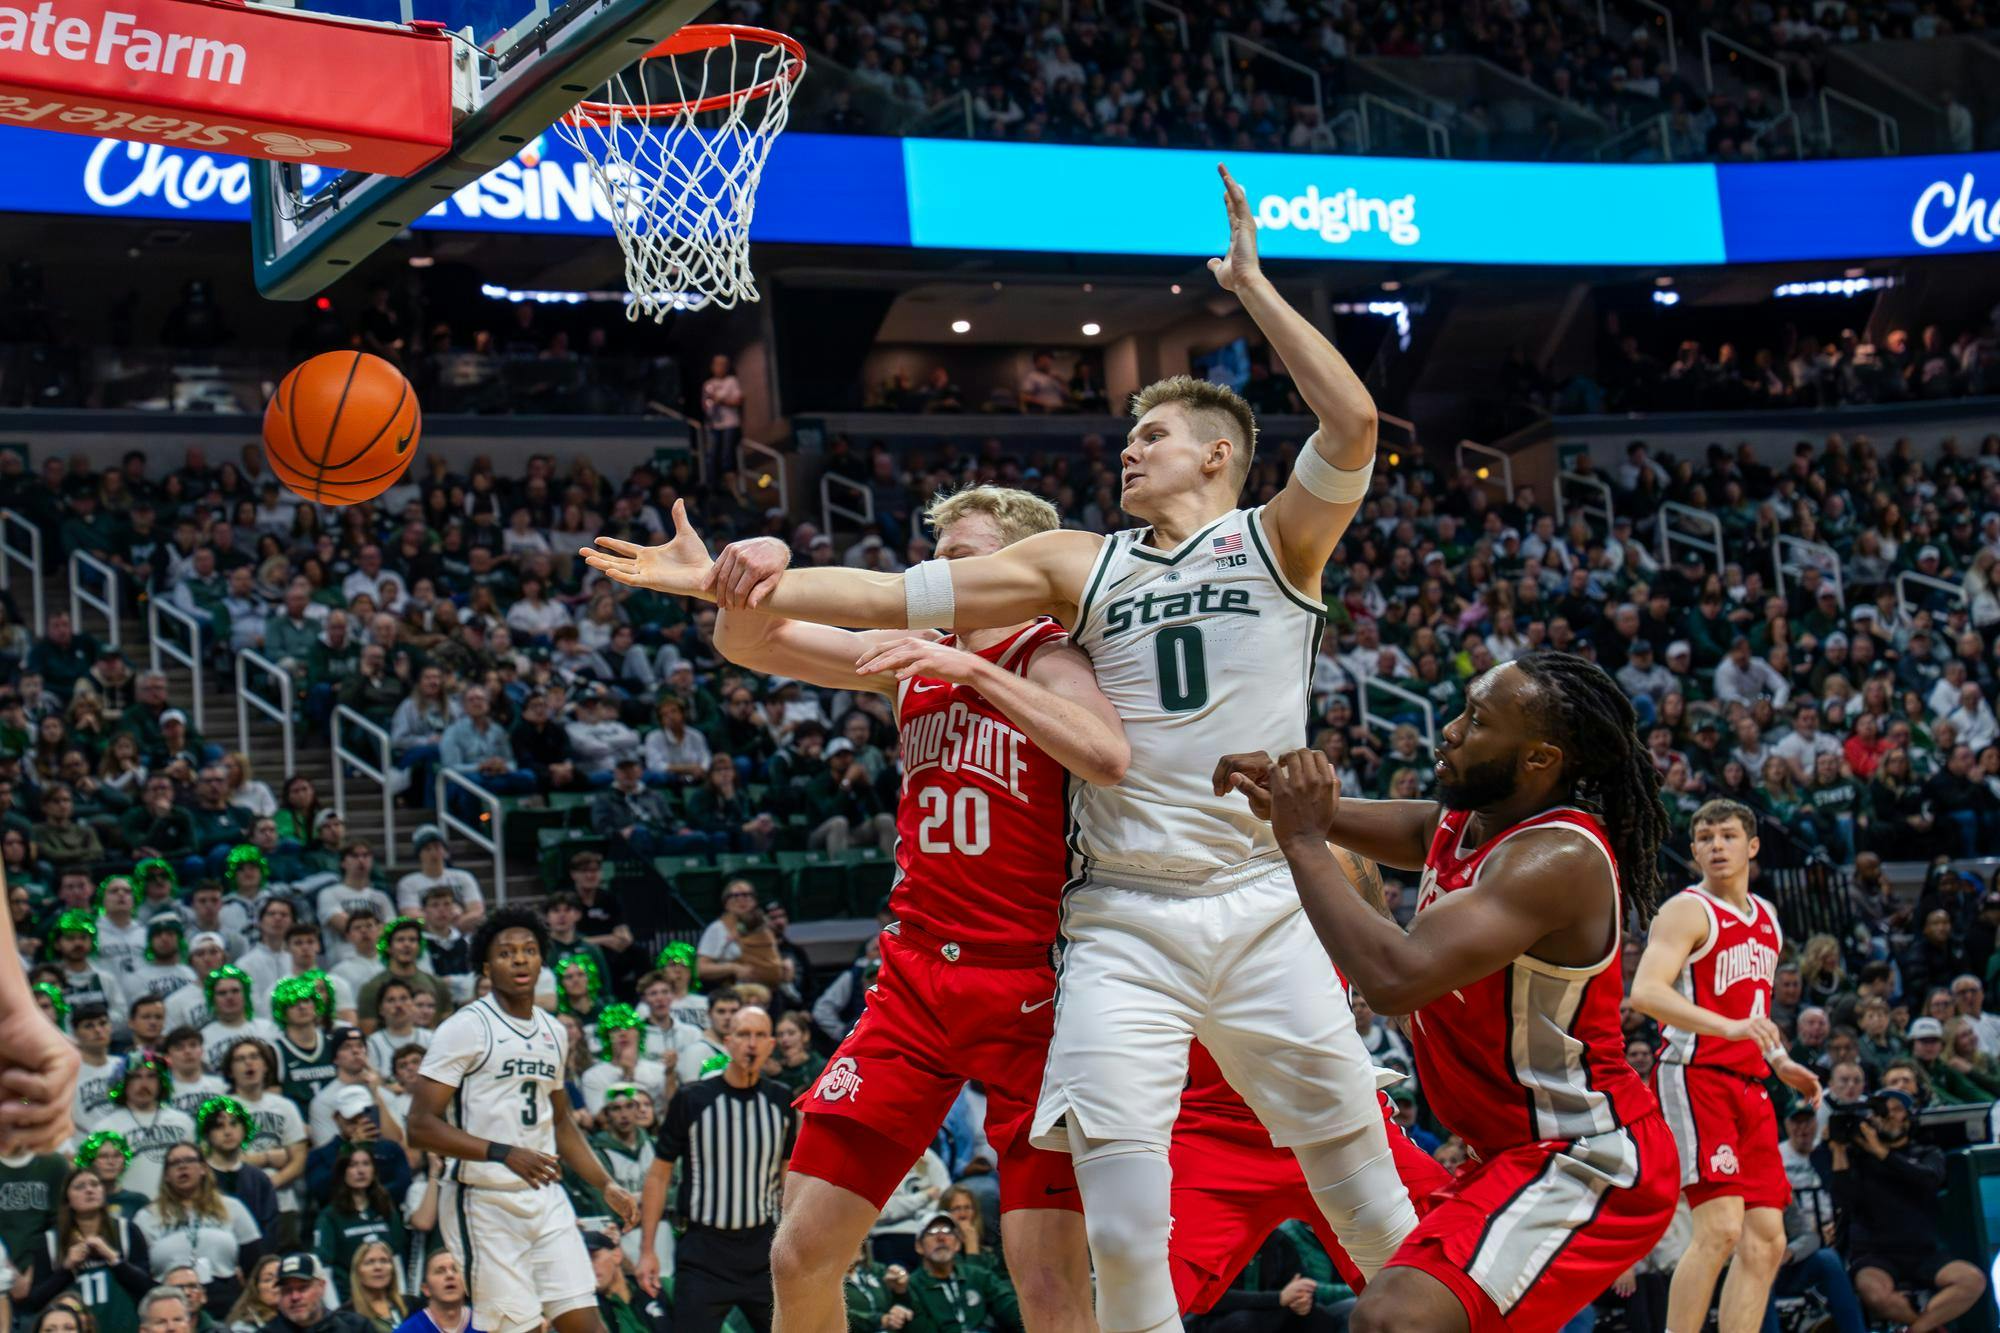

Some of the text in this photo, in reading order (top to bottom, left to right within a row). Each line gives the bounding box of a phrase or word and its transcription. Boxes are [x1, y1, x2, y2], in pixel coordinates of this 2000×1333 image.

[1103, 584, 1261, 642] State
[1154, 624, 1210, 715] 0
[918, 786, 991, 856] 20
[495, 1058, 556, 1080] State
[520, 1080, 538, 1126] 3
[77, 1271, 108, 1305] 11
